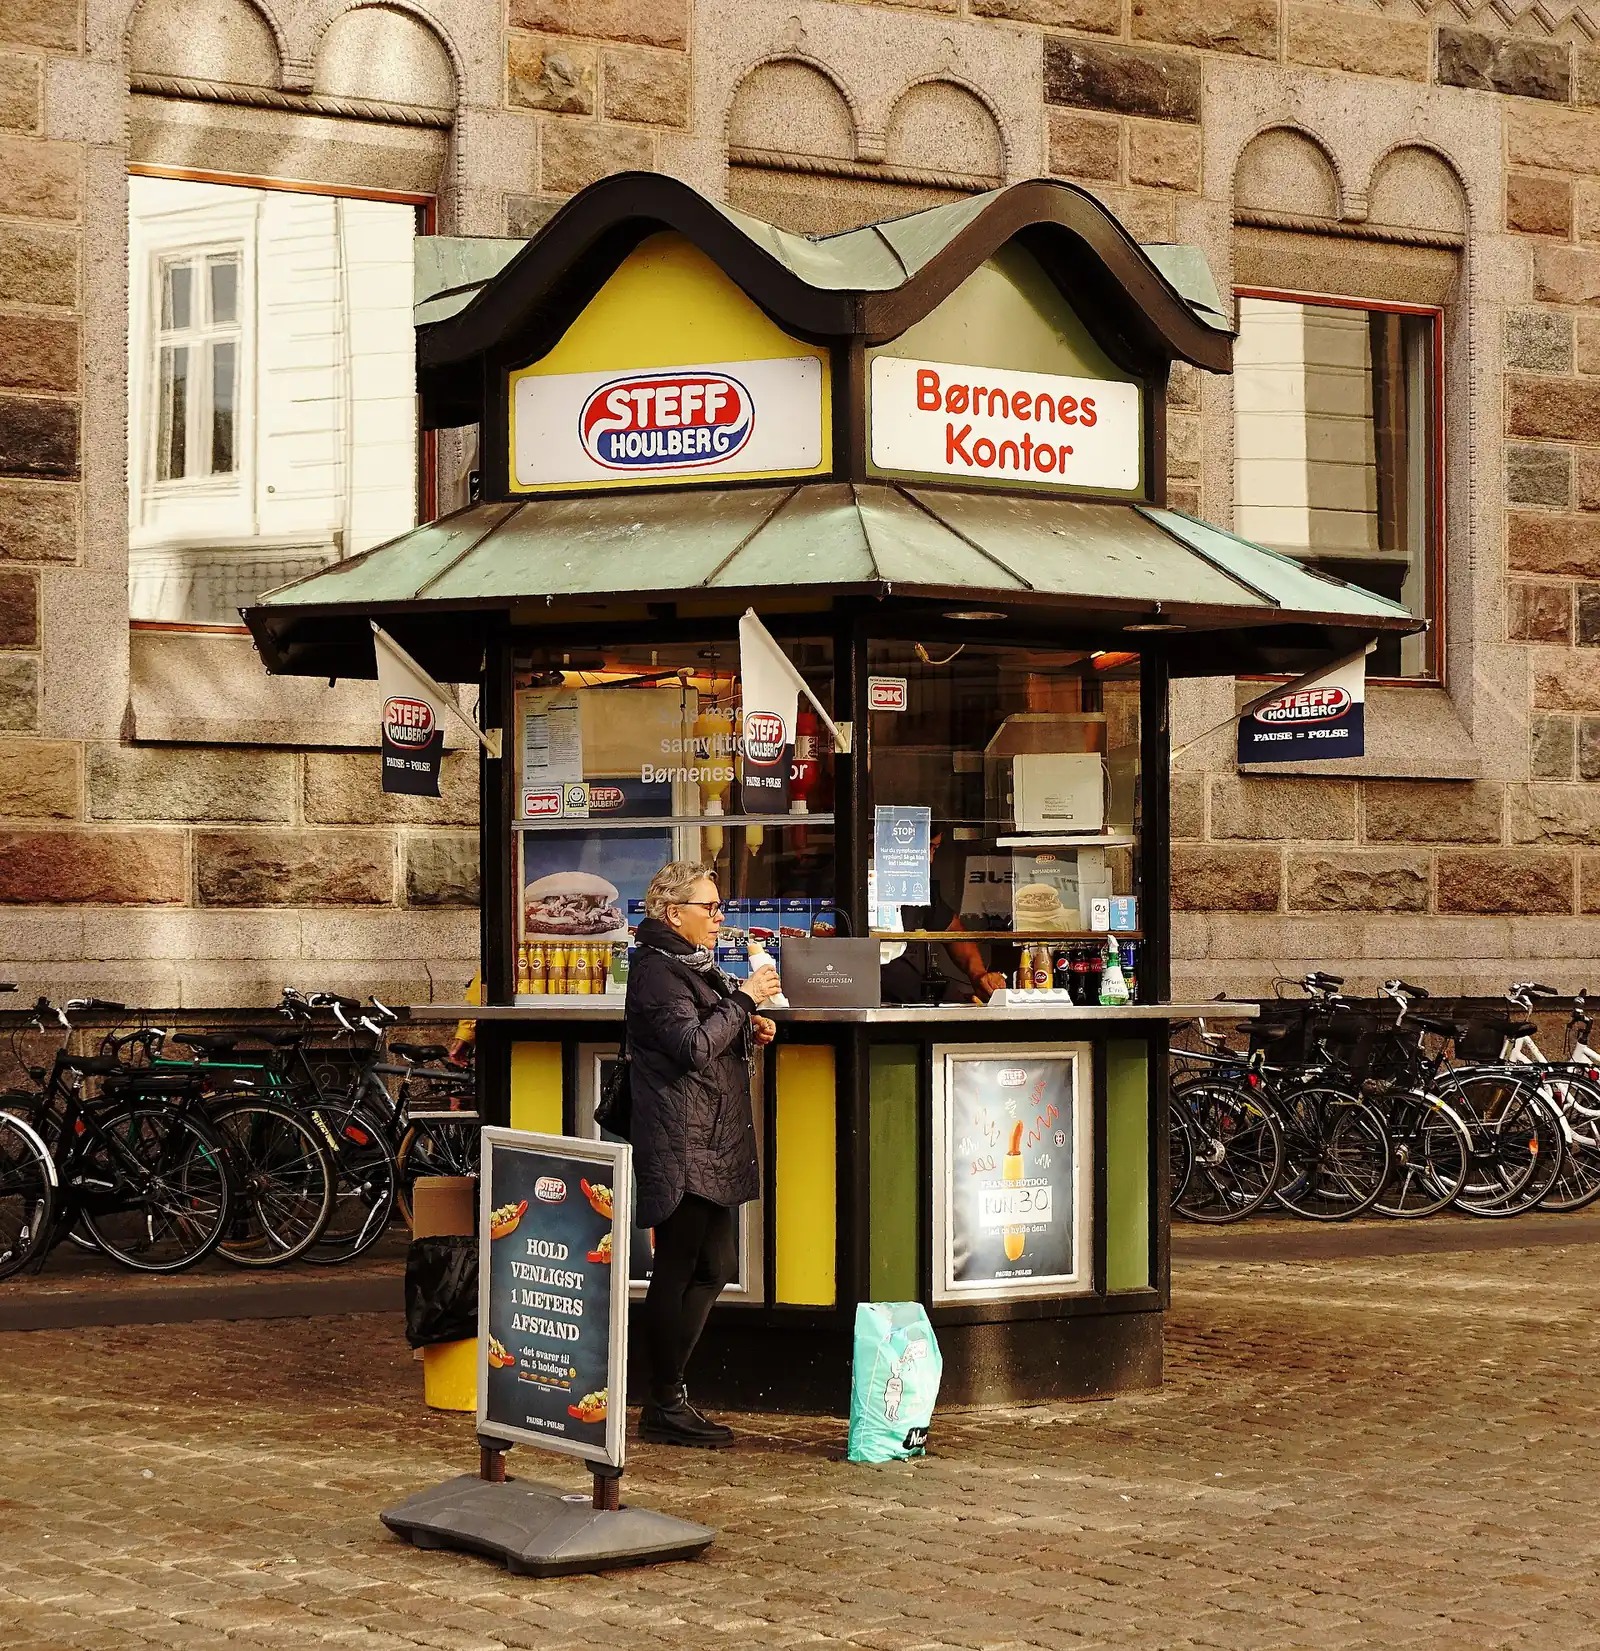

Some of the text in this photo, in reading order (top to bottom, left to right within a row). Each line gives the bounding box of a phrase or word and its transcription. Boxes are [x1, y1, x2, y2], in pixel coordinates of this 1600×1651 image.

[602, 383, 729, 430] STEFF
[917, 369, 1097, 427] Børnenes
[610, 425, 730, 459] HOULBERG
[946, 422, 1074, 474] Kontor
[872, 690, 902, 702] DK
[1268, 689, 1336, 708] STEFF
[388, 701, 427, 728] STEFF
[1267, 705, 1337, 720] HOULBERG
[390, 724, 427, 742] HOULBERG
[749, 717, 781, 742] STEFF
[1253, 732, 1293, 742] PAUSE
[1308, 728, 1349, 739] PØLSE
[750, 740, 779, 758] HOULBERG
[386, 757, 405, 769] PAUSE
[411, 760, 431, 772] PØLSE
[641, 763, 735, 784] Børnenes
[746, 776, 761, 787] PAUSE
[589, 789, 618, 800] TEFF
[527, 798, 559, 811] DK
[589, 800, 618, 808] OULBERG
[893, 827, 916, 836] STOP!
[540, 1179, 563, 1192] STEFF
[526, 1238, 569, 1261] HOLD
[510, 1261, 584, 1290] VENLIGST
[511, 1288, 583, 1316] 1 METERS
[511, 1313, 580, 1341] AFSTAND
[523, 1346, 534, 1357] det
[535, 1350, 560, 1362] svarer
[560, 1353, 570, 1364] til
[520, 1359, 568, 1378] ca. 5 hotdogs
[526, 1415, 544, 1427] PAUSE
